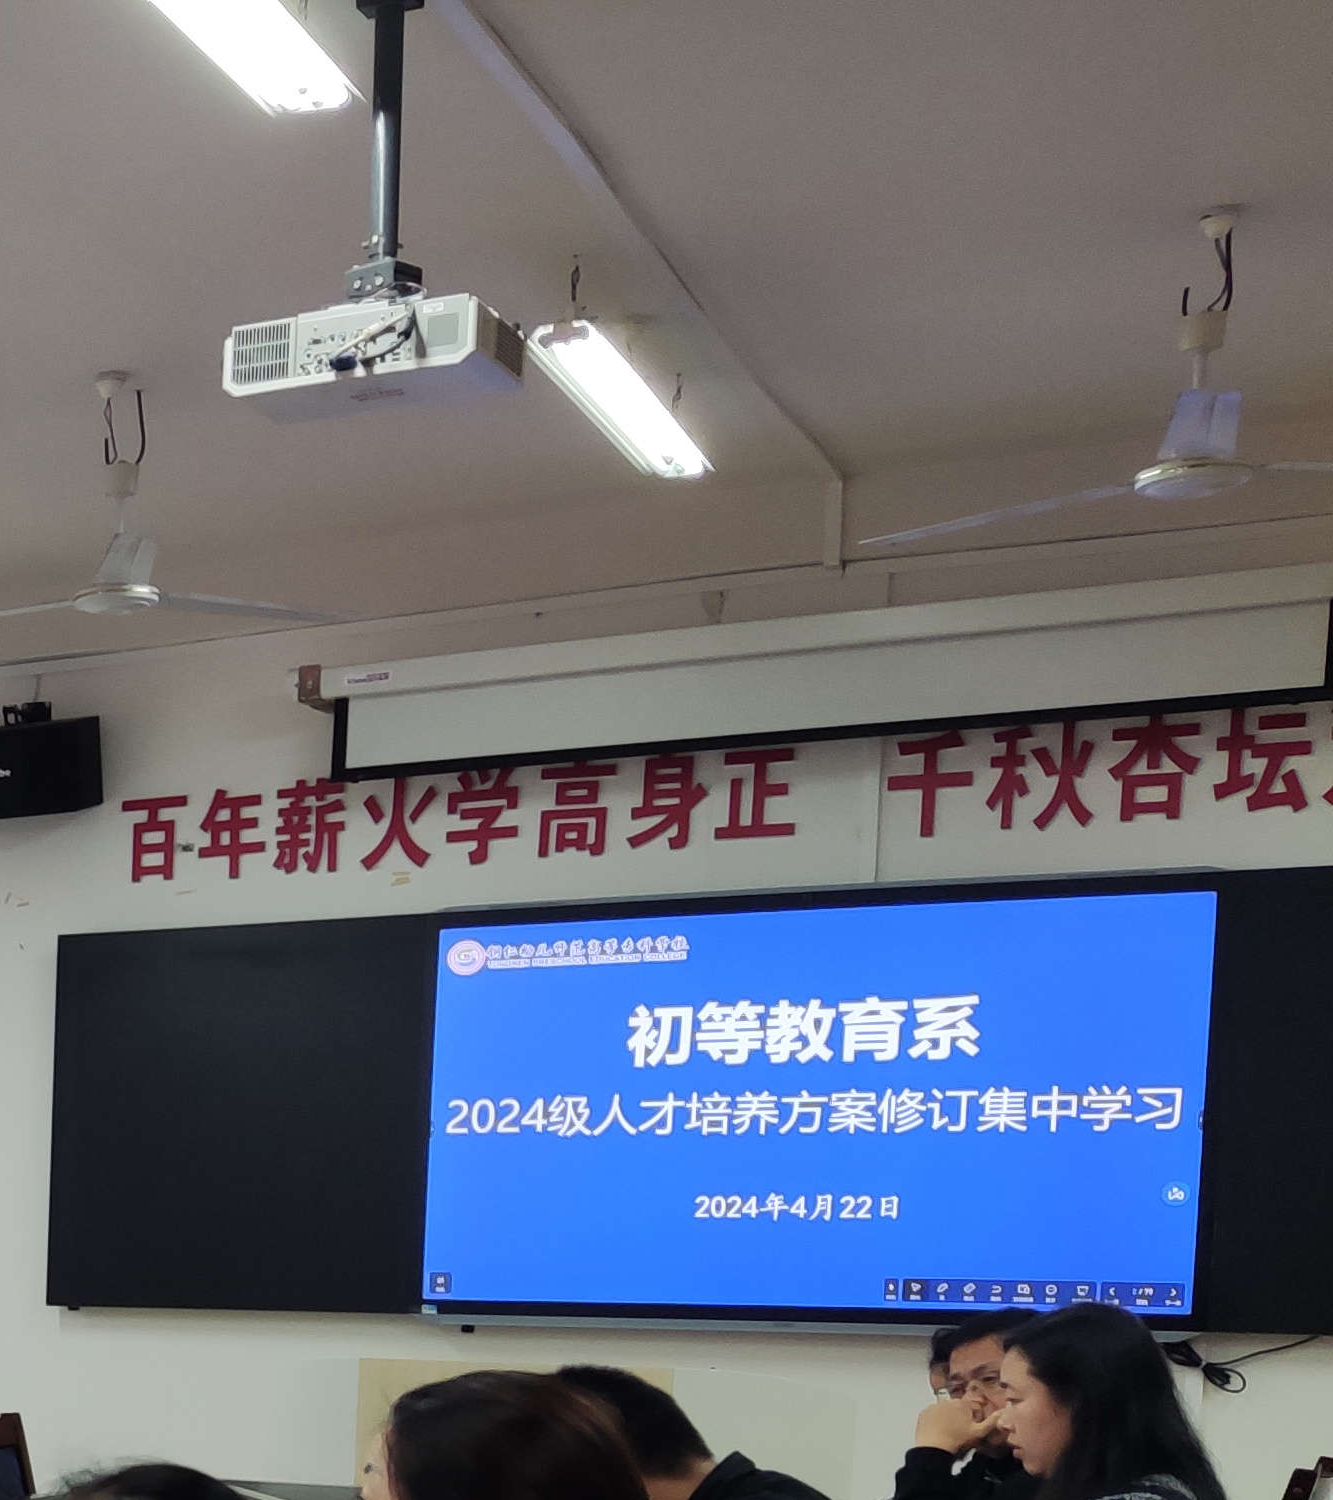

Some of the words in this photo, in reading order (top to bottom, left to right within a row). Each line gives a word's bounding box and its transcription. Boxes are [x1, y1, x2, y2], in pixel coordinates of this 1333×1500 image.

[122, 748, 796, 883] 百年薪火学高身正
[887, 708, 1333, 838] 千秋杏坛
[627, 995, 979, 1067] 初等教育系
[445, 1086, 1183, 1136] 2024级人才培养方案修订集中学习
[695, 1193, 900, 1221] 2024年4月22日
